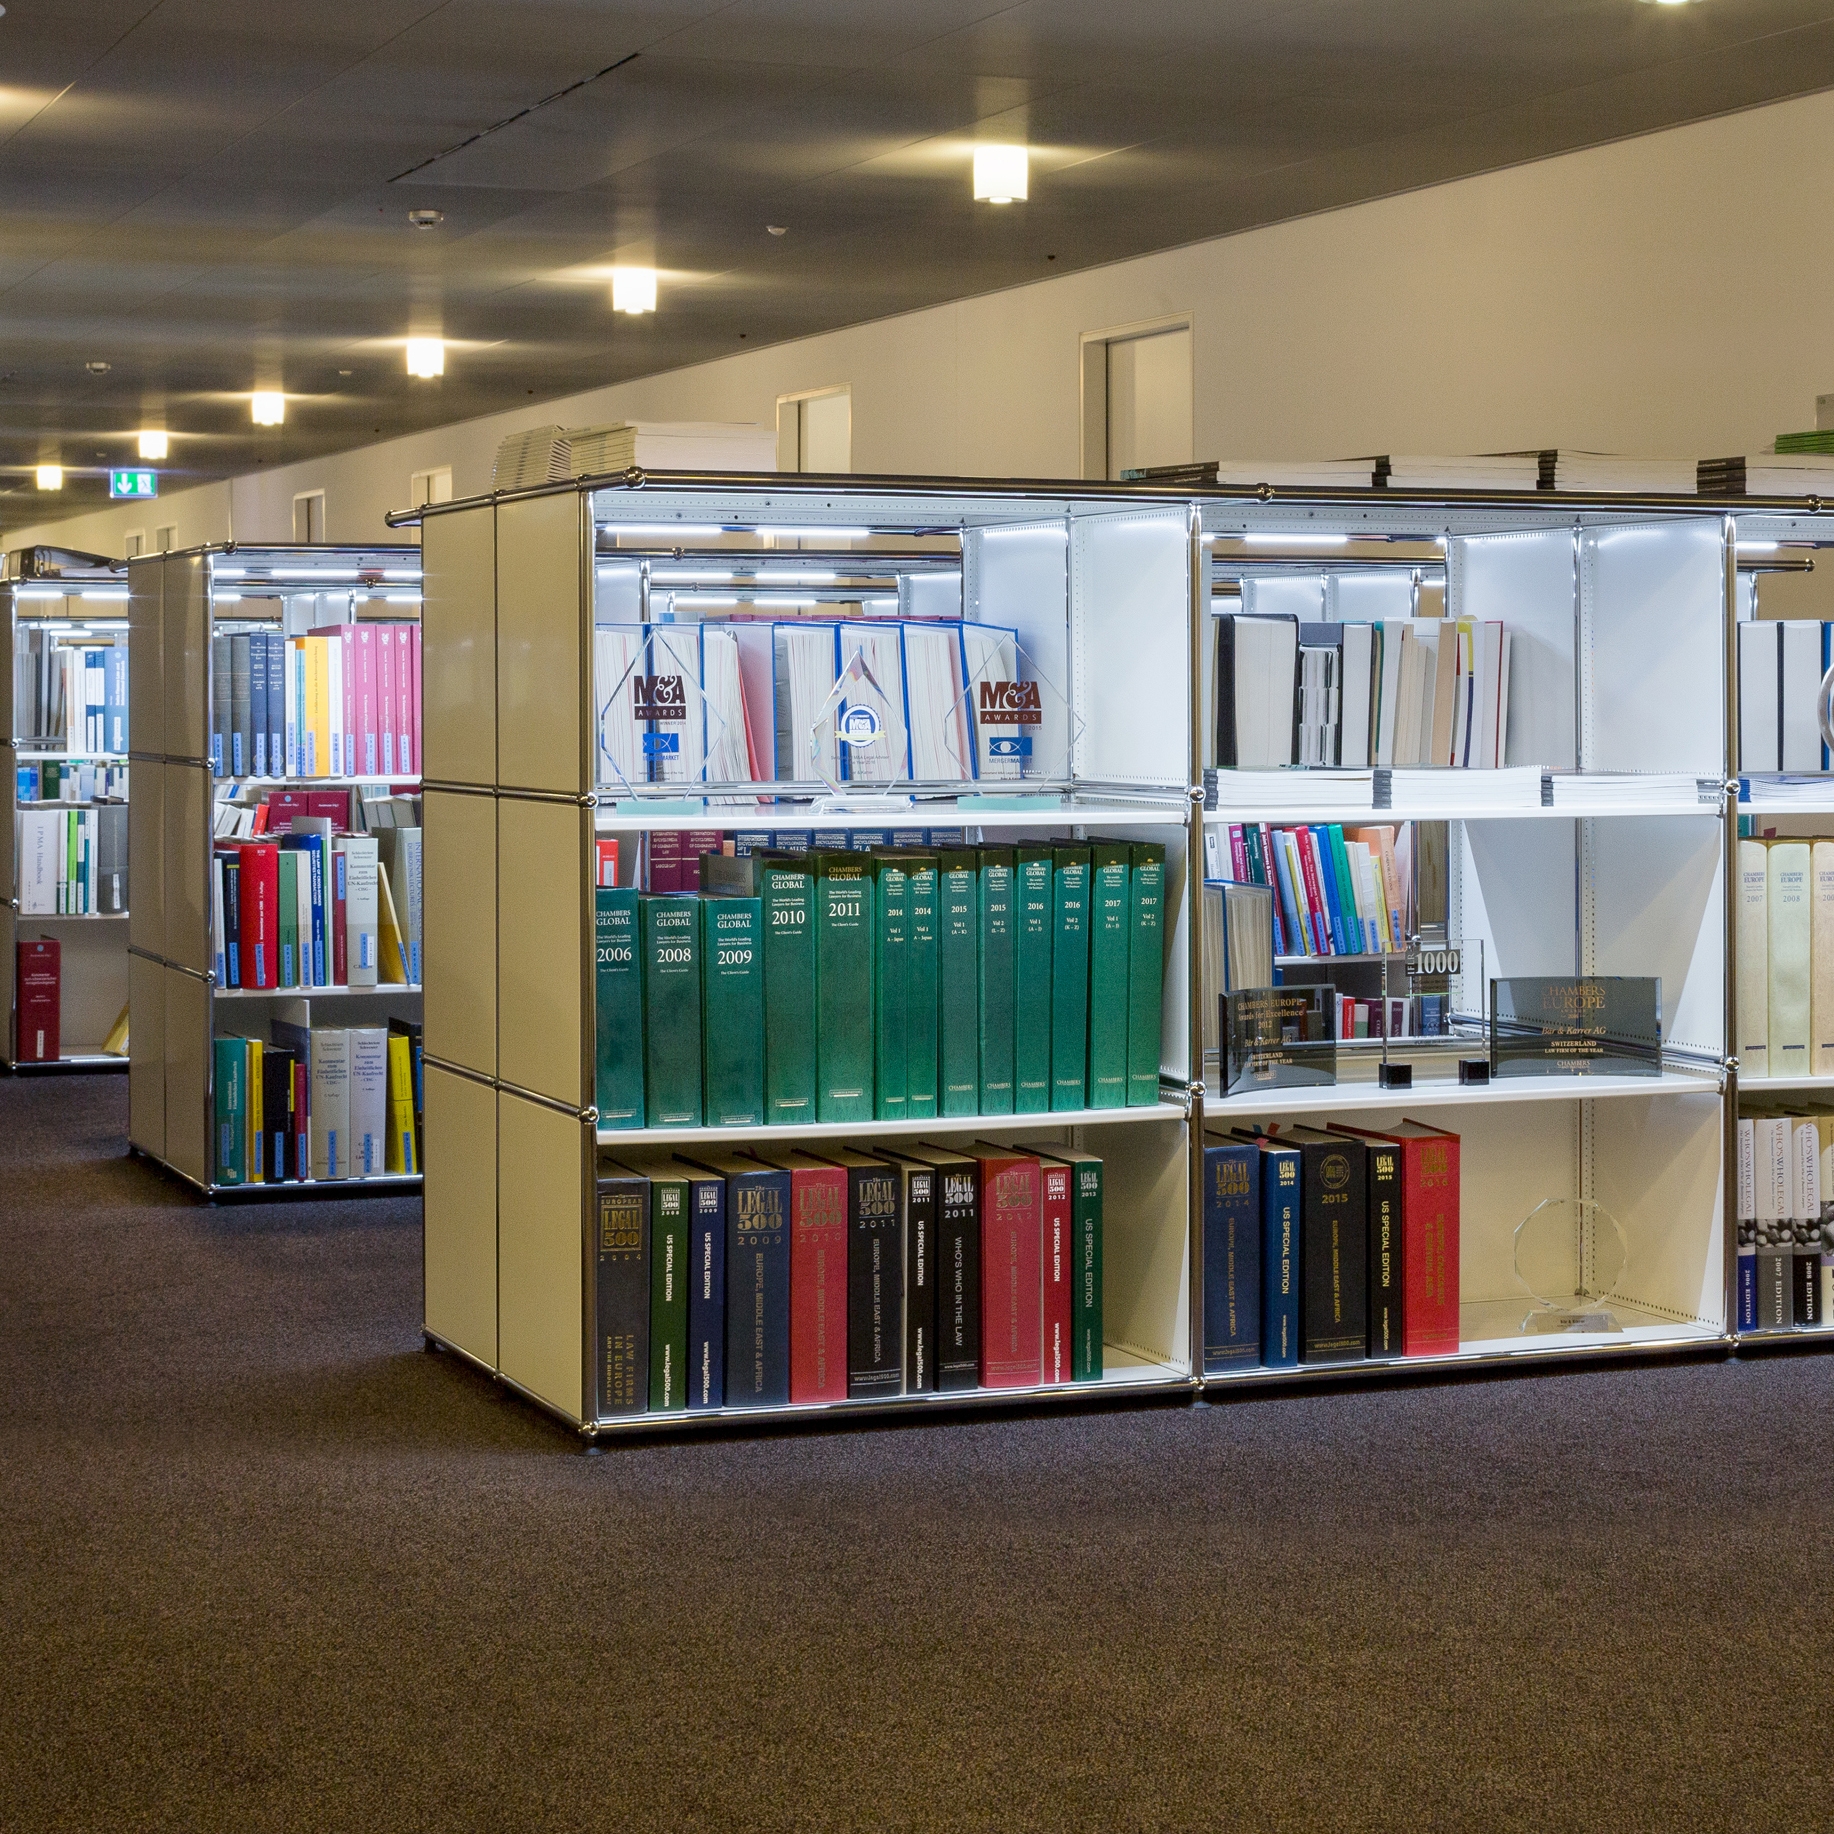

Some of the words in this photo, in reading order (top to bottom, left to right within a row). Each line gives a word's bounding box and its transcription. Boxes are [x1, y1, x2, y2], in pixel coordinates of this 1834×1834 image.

[634, 675, 686, 705] M&A
[980, 681, 1041, 709] M&A
[638, 708, 682, 716] AWARDS
[828, 873, 862, 882] GLOBAL
[772, 881, 804, 889] GLOBAL
[596, 910, 631, 918] CHAMBERS
[828, 902, 860, 917] 2011
[596, 917, 631, 926] GLOBAL
[656, 918, 691, 926] GLOBAL
[717, 912, 752, 920] CHAMBERS
[772, 910, 805, 925] 2010
[717, 920, 752, 928] GLOBAL
[596, 947, 632, 962] 2006
[656, 948, 692, 962] 2008
[718, 950, 752, 965] 2009
[1416, 951, 1458, 974] 1000
[1238, 1000, 1268, 1010] CHAMBERS
[1270, 998, 1302, 1007] EUROPE
[1543, 997, 1606, 1009] EUROPE
[1265, 1010, 1303, 1018] Excellence
[1258, 1021, 1272, 1029] 2012
[1594, 1027, 1606, 1035] AG
[1280, 1162, 1295, 1172] LEGAL
[1377, 1156, 1393, 1167] LEGAL
[1081, 1172, 1098, 1182] LEGAL
[1216, 1163, 1249, 1183] LEGAL
[914, 1179, 929, 1189] LEGAL
[945, 1175, 974, 1193] LEGAL
[1216, 1181, 1250, 1195] 500
[662, 1193, 678, 1201] LEGAL
[700, 1190, 716, 1200] LEGAL
[859, 1180, 895, 1202] LEGAL
[737, 1190, 782, 1214] LEGAL
[945, 1192, 974, 1204] 500
[1322, 1194, 1348, 1203] 2015
[859, 1201, 895, 1216] 500
[1283, 1207, 1290, 1219] US
[1382, 1201, 1389, 1213] US
[945, 1209, 974, 1218] 2011
[604, 1210, 638, 1230] LEGAL
[737, 1212, 782, 1230] 500
[859, 1219, 895, 1228] 2011
[1085, 1219, 1093, 1231] US
[604, 1231, 638, 1246] 500
[666, 1235, 673, 1244] US
[737, 1235, 782, 1245] 2009
[1282, 1221, 1290, 1257] SPECIAL
[1085, 1234, 1093, 1270] SPECIAL
[755, 1253, 763, 1292] EUROPE,
[1085, 1272, 1093, 1308] EDITION
[955, 1295, 962, 1304] IN
[615, 1336, 623, 1349] IN
[626, 1335, 634, 1360] LAW
[916, 1328, 924, 1389] www.legal500.com
[615, 1355, 623, 1405] EUROPE
[663, 1344, 671, 1407] www.legal500.com
[626, 1366, 634, 1405] FIRMS
